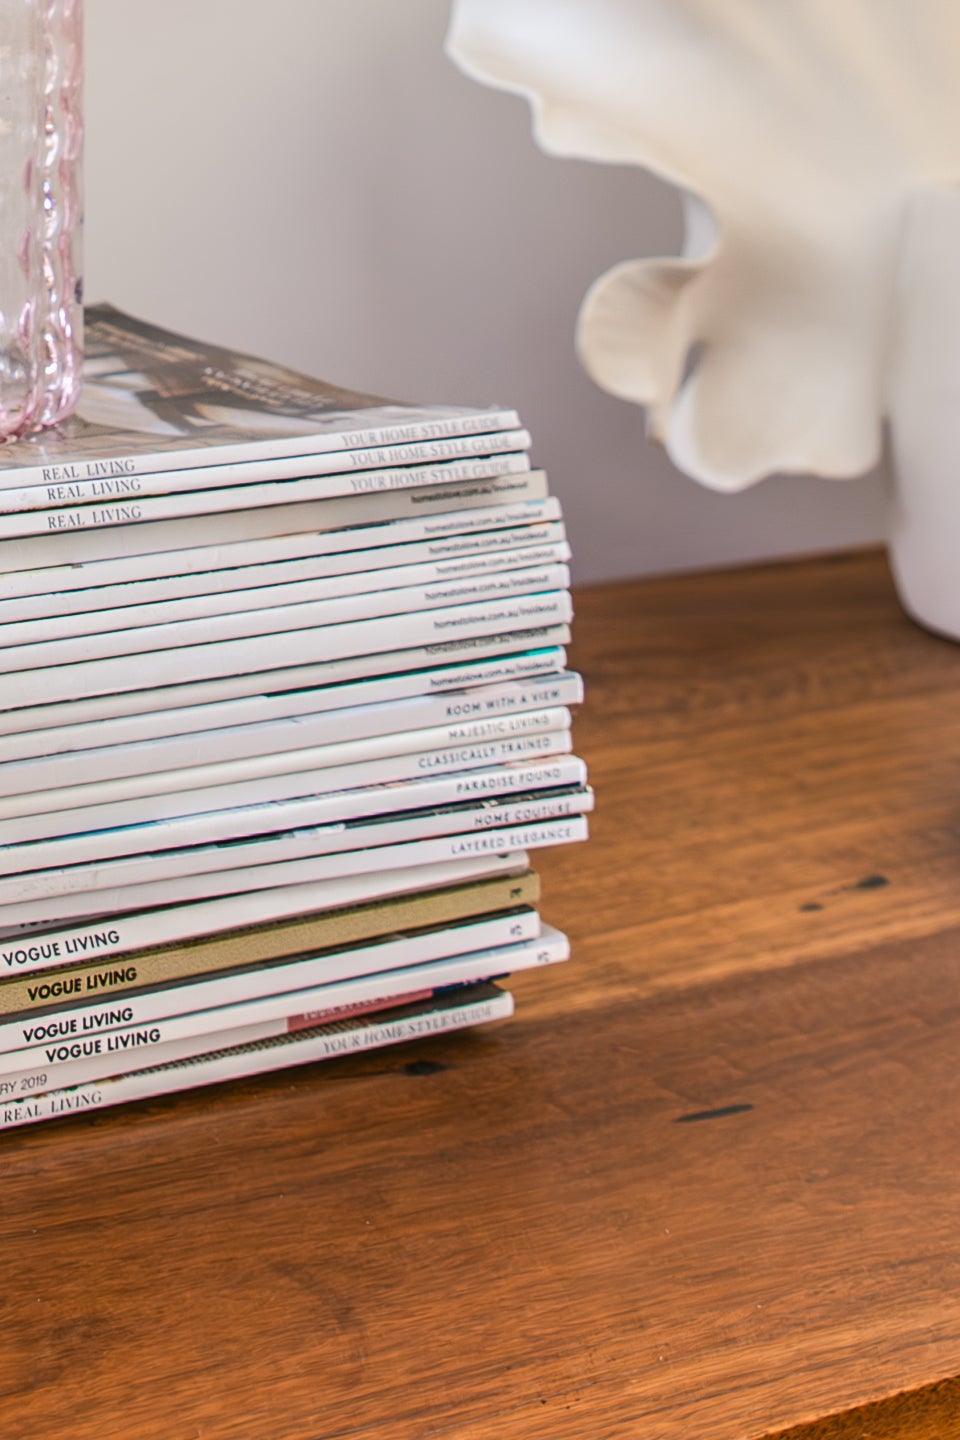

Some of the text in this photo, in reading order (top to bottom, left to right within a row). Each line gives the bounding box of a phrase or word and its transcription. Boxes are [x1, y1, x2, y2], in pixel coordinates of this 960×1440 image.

[341, 430, 376, 447] YOUR
[380, 424, 420, 443] HOME
[422, 420, 460, 438] STYLE
[350, 450, 386, 466] YOUR
[390, 444, 428, 461] HOME
[430, 439, 469, 456] STYLE
[42, 460, 135, 481] REAL LIVING
[350, 476, 386, 492] YOUR
[390, 471, 429, 488] HOME
[432, 466, 470, 482] STYLE
[47, 478, 140, 500] REAL LIVING
[48, 506, 141, 528] REAL LIVING
[446, 690, 560, 716] ROOM WITH A VIEW
[449, 716, 549, 740] MAJESTIC LIVING
[418, 738, 550, 768] CLASSICALLY TRAINED
[457, 768, 560, 792] PARADISE FOUND
[474, 804, 571, 826] HOME COUTURE
[451, 828, 571, 854] LAYERED ELEGANCE
[3, 930, 120, 966] VOGUE LIVING
[28, 966, 137, 1001] VOGUE LIVING
[22, 1008, 134, 1042] VOGUE LIVING
[322, 1034, 360, 1055] YOUR
[364, 1026, 406, 1046] HOME
[408, 1016, 450, 1036] STYLE
[46, 1028, 161, 1062] VOGUE LIVING
[20, 1074, 48, 1092] 2019
[4, 1091, 102, 1123] REAL LIVING
